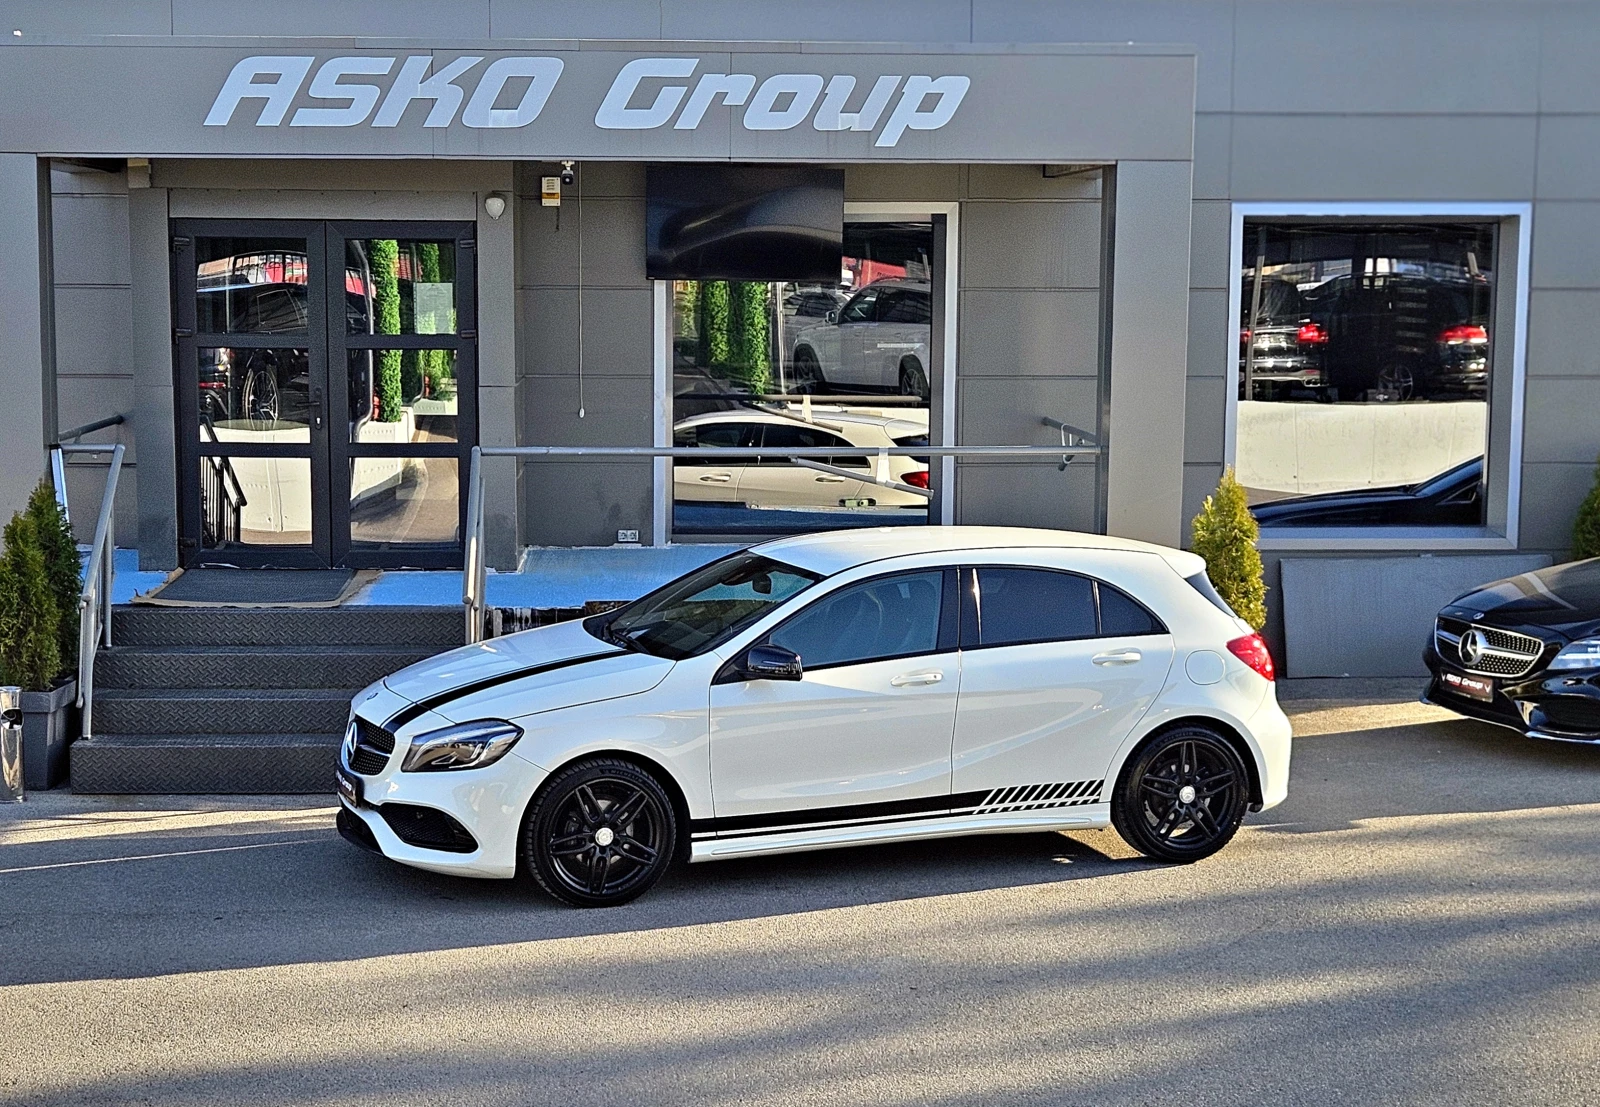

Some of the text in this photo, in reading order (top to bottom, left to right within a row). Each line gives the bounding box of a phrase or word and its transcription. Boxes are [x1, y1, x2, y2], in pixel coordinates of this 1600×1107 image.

[203, 55, 971, 147] ASKO Group
[1462, 678, 1484, 689] Group
